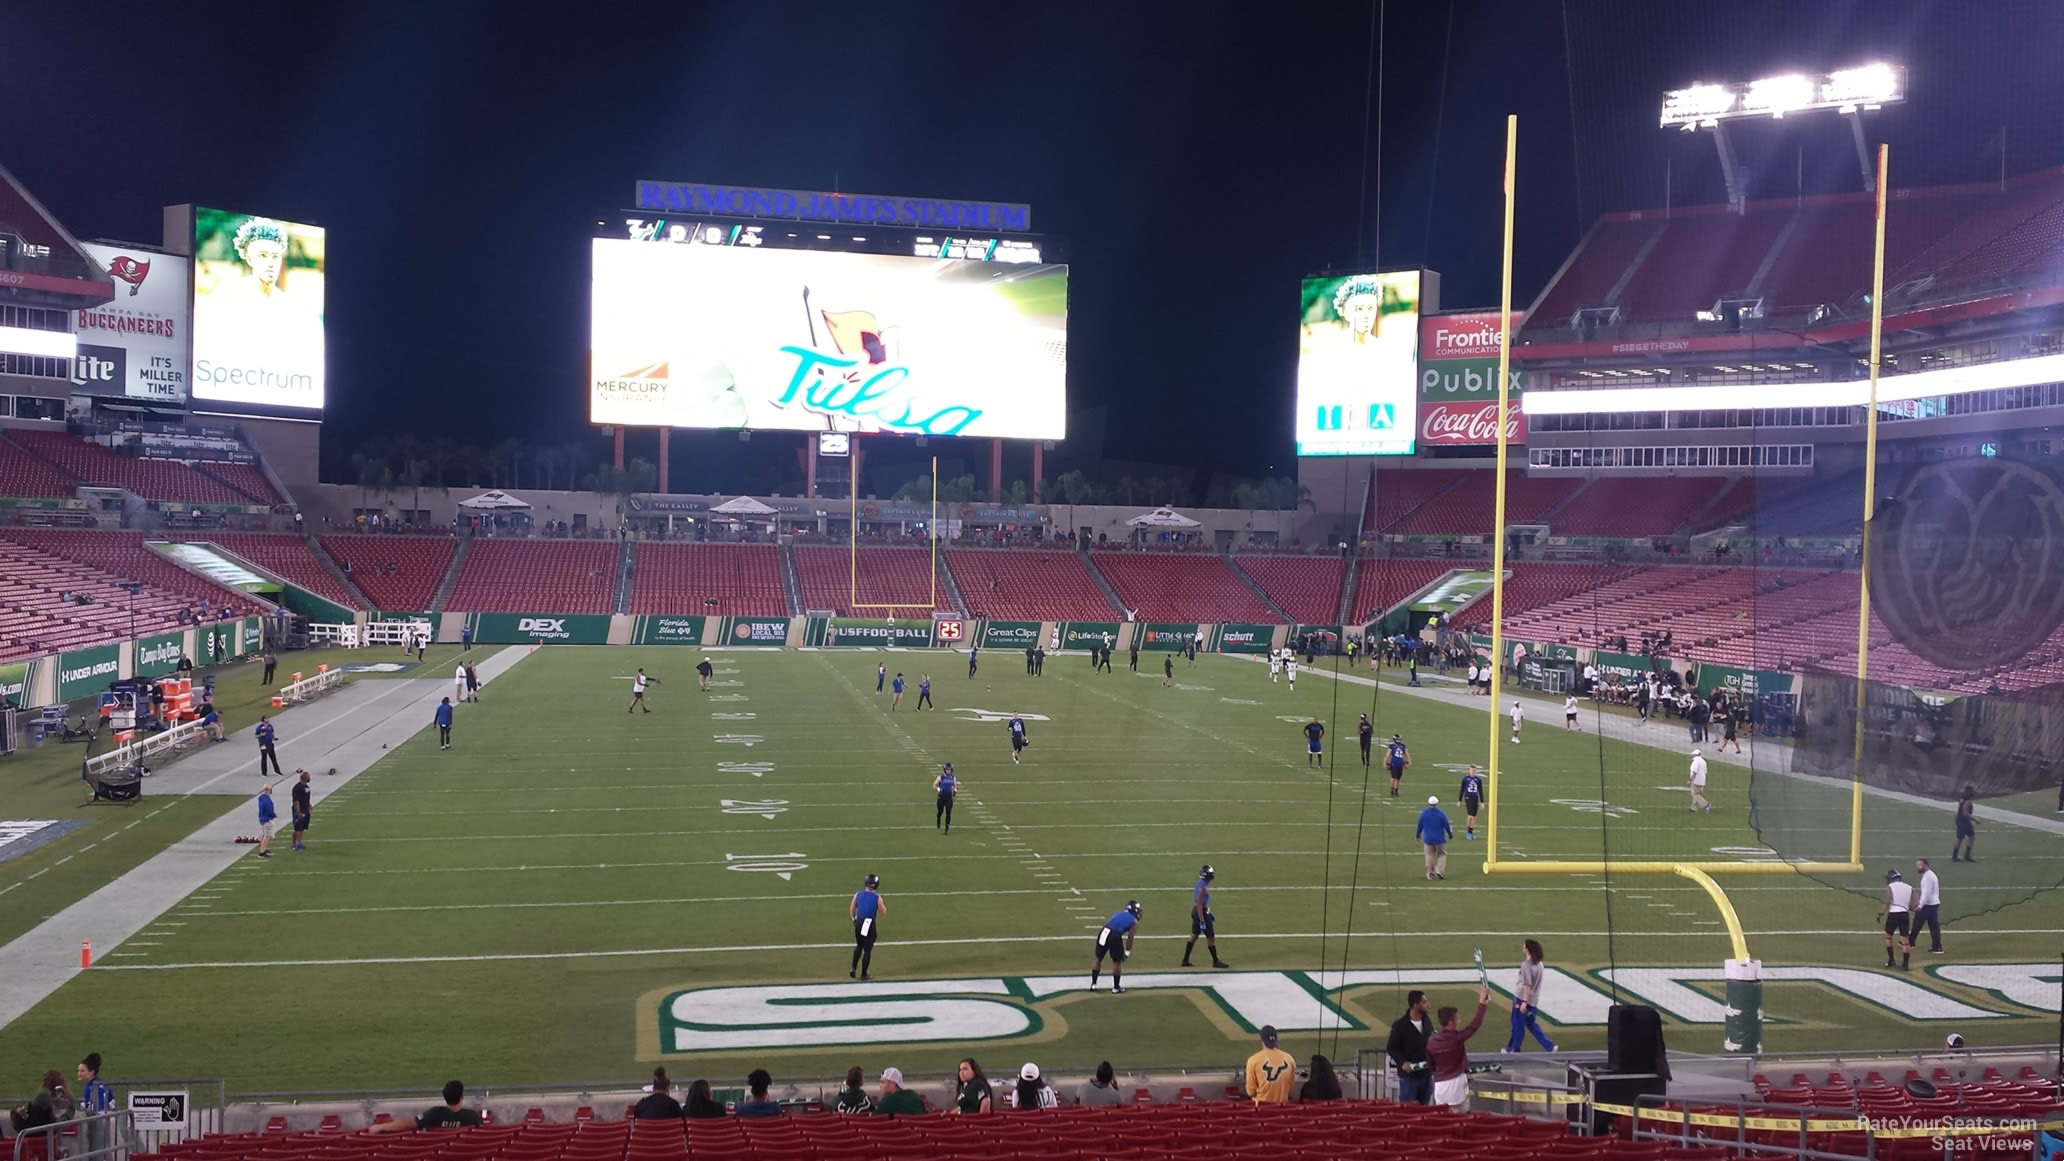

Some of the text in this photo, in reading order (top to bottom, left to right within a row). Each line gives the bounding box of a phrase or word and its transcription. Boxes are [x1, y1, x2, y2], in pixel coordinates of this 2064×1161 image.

[641, 183, 1025, 228] RAYMOND JAMES STADIUM
[78, 309, 175, 339] BUCCANEERS
[1436, 329, 1502, 347] Frontie
[1612, 341, 1689, 352] #SIEGETHEDAY
[150, 356, 172, 368] IT'S
[70, 355, 115, 386] Lite
[140, 369, 182, 382] MILLER
[196, 359, 312, 391] Spectrum
[147, 383, 175, 394] TIME
[596, 381, 669, 392] MERCURY
[777, 346, 984, 434] Tulsa
[518, 618, 566, 632] DEX
[658, 619, 689, 627] Florida
[751, 623, 785, 631] IBEW
[529, 630, 570, 638] imaging
[658, 626, 676, 634] Blue
[839, 628, 928, 638] USFFOOBALL
[941, 623, 959, 637] 25
[988, 627, 1037, 638] Great Clips
[1223, 631, 1254, 641] schutt
[70, 660, 118, 681] UNDER ARMOUR
[1607, 665, 1632, 676] UNDER
[1726, 674, 1741, 685] TGH
[1467, 784, 1478, 793] 23
[134, 1097, 166, 1105] WARNING
